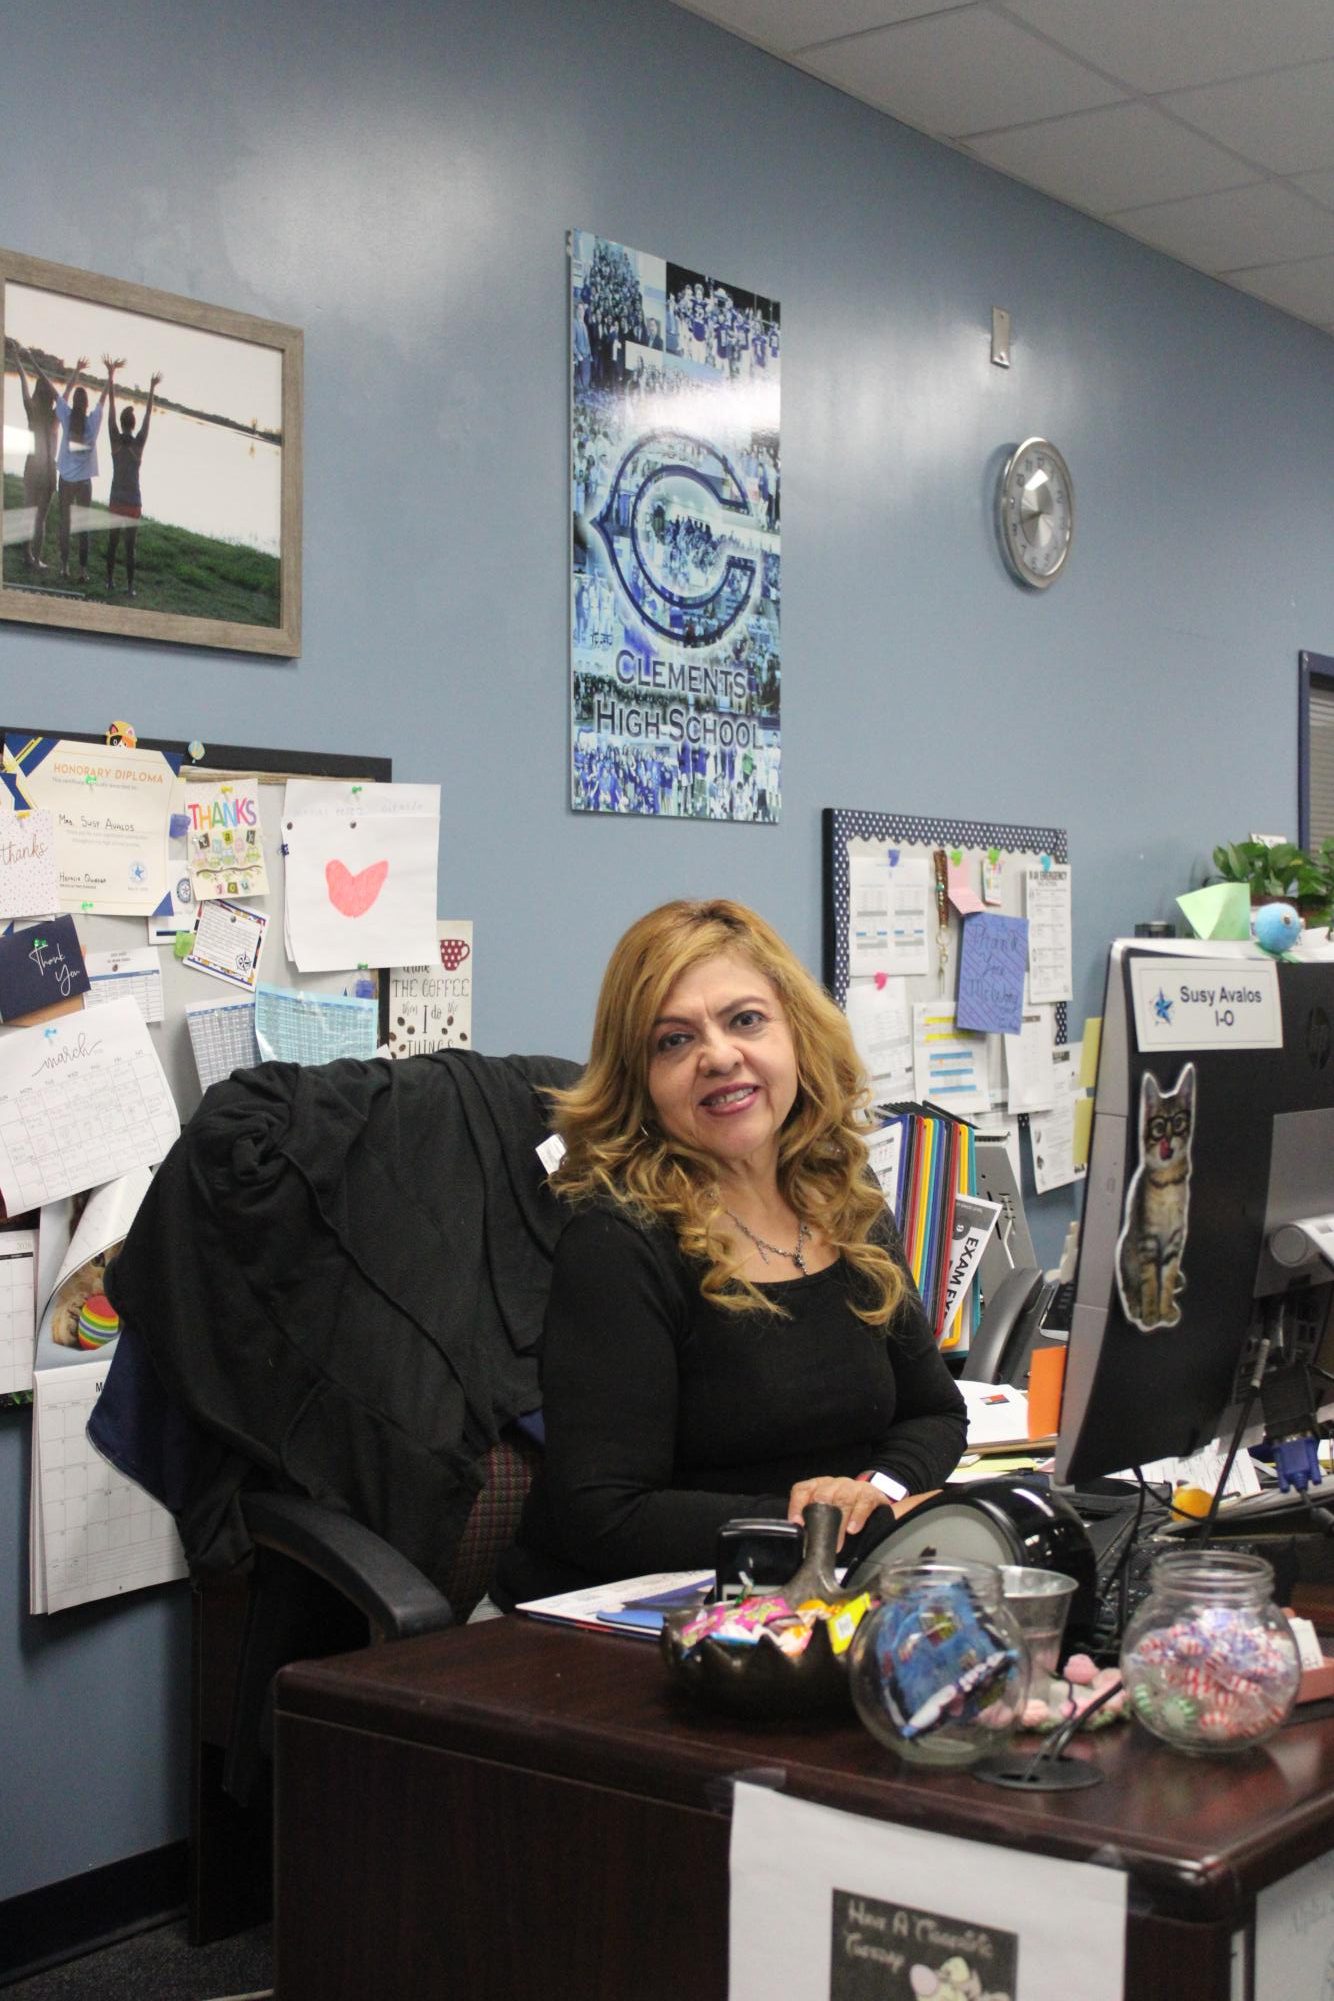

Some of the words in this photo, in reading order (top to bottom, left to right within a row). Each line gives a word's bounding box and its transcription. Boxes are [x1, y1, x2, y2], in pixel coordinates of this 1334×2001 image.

[615, 649, 747, 699] CLEMENTS
[596, 699, 660, 740] HIGH
[668, 707, 763, 750] SCHOOL
[53, 762, 111, 779] HONORARY
[114, 768, 164, 784] DIPLOMA
[188, 797, 258, 831] THANKS
[1, 833, 48, 865] thanks
[28, 943, 66, 976] Thank
[392, 979, 418, 998] THE
[422, 978, 470, 998] COFFEE
[1179, 986, 1216, 1006] Susy
[1219, 986, 1262, 1004] Avalos
[950, 1236, 979, 1286] EXAM
